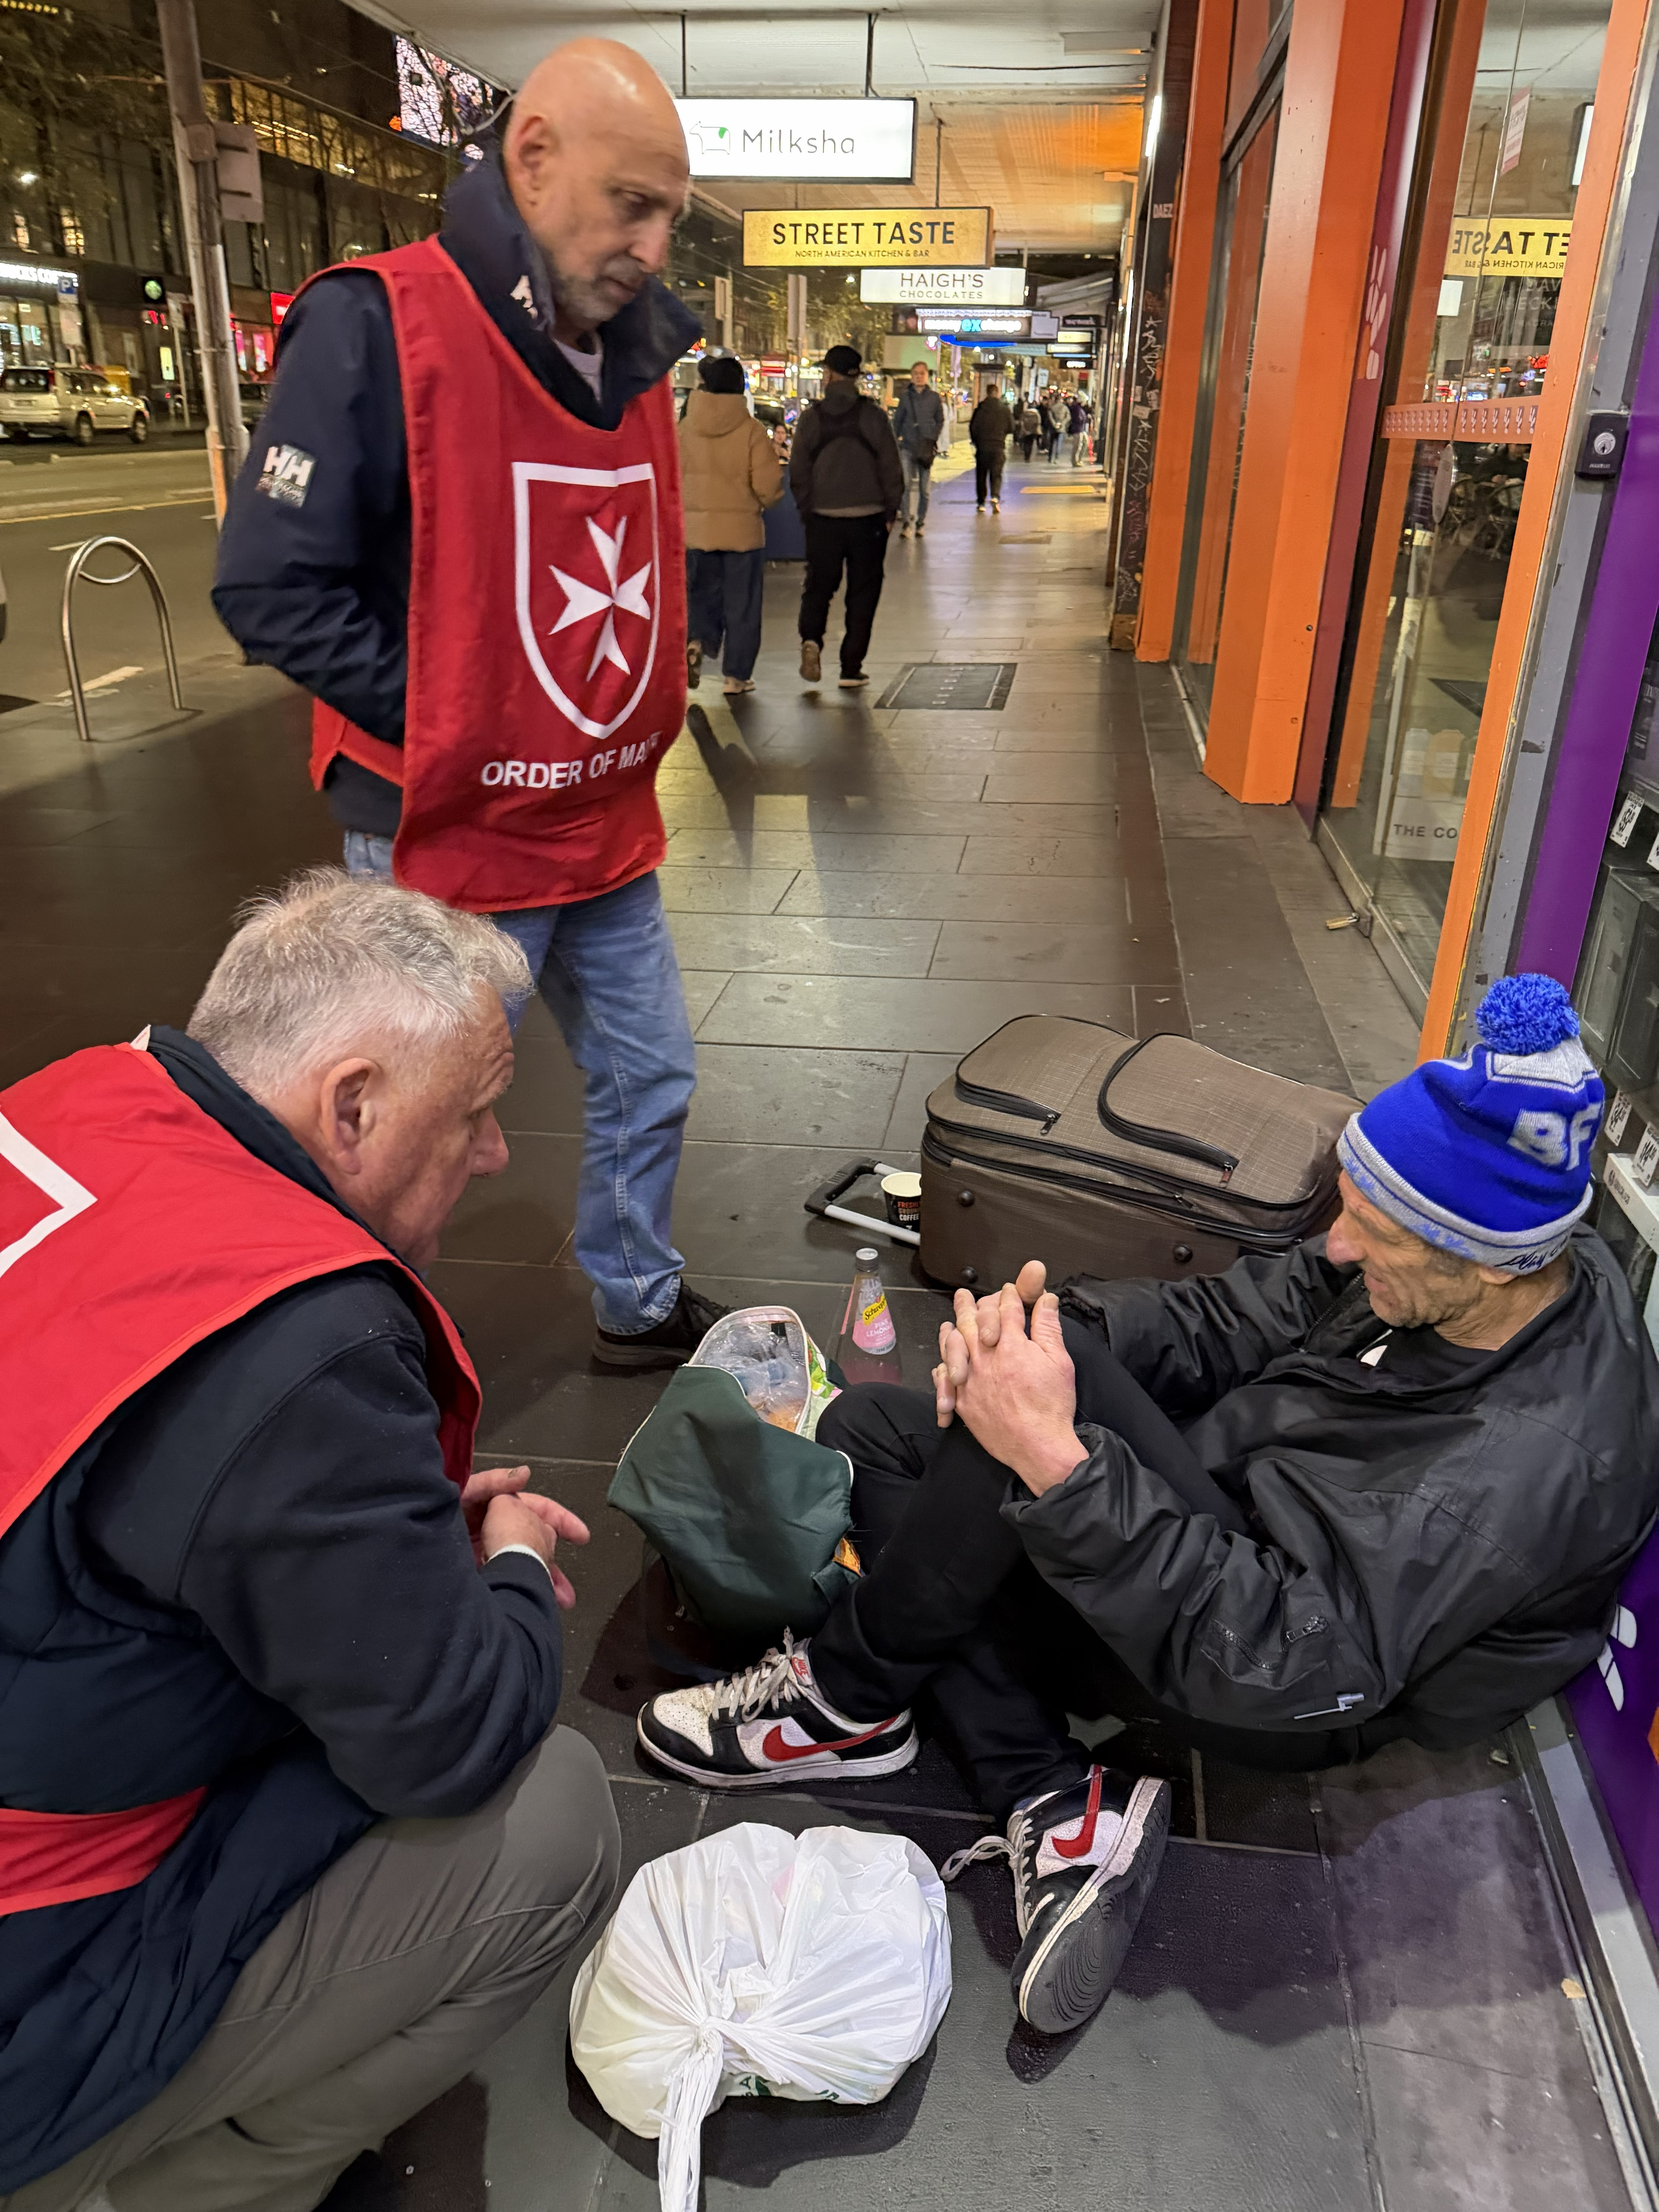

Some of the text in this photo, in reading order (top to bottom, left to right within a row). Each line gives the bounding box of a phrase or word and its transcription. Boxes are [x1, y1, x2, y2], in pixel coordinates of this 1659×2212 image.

[743, 130, 854, 153] Milksha
[773, 222, 955, 245] STREET TASTE
[901, 273, 984, 288] HAIGH'S
[900, 290, 983, 299] CHOCOLATES
[263, 446, 313, 487] HH
[481, 760, 583, 789] ORDER
[589, 749, 617, 779] OF
[1394, 824, 1426, 837] THE
[899, 1213, 920, 1221] COFFEE
